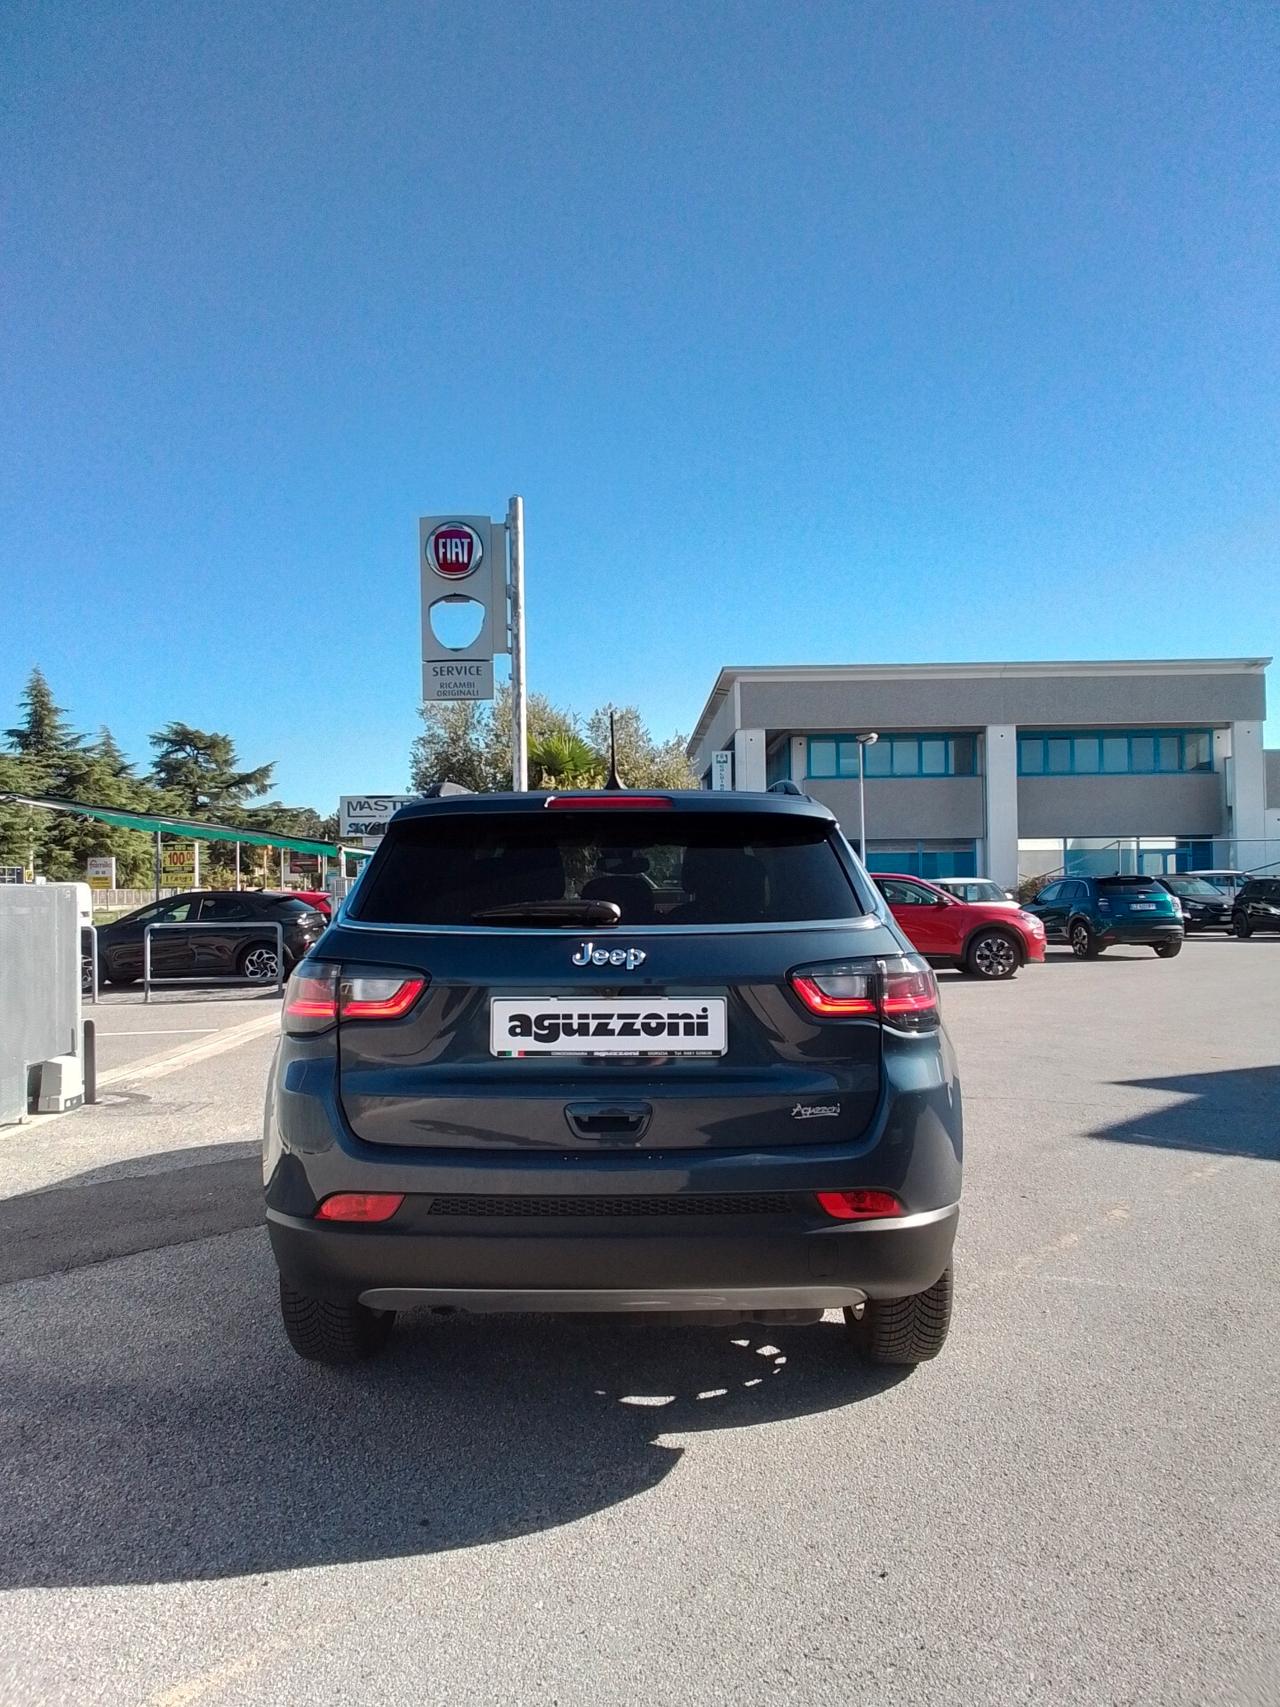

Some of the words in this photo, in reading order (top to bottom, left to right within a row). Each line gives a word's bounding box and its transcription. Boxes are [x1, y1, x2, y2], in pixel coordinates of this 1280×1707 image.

[438, 537, 471, 564] FIAT
[432, 665, 483, 677] SERVICE
[436, 689, 480, 698] ORIGINALI
[439, 681, 475, 690] RICAMBI
[572, 942, 647, 970] Jeep
[508, 1007, 710, 1044] aguzzoni
